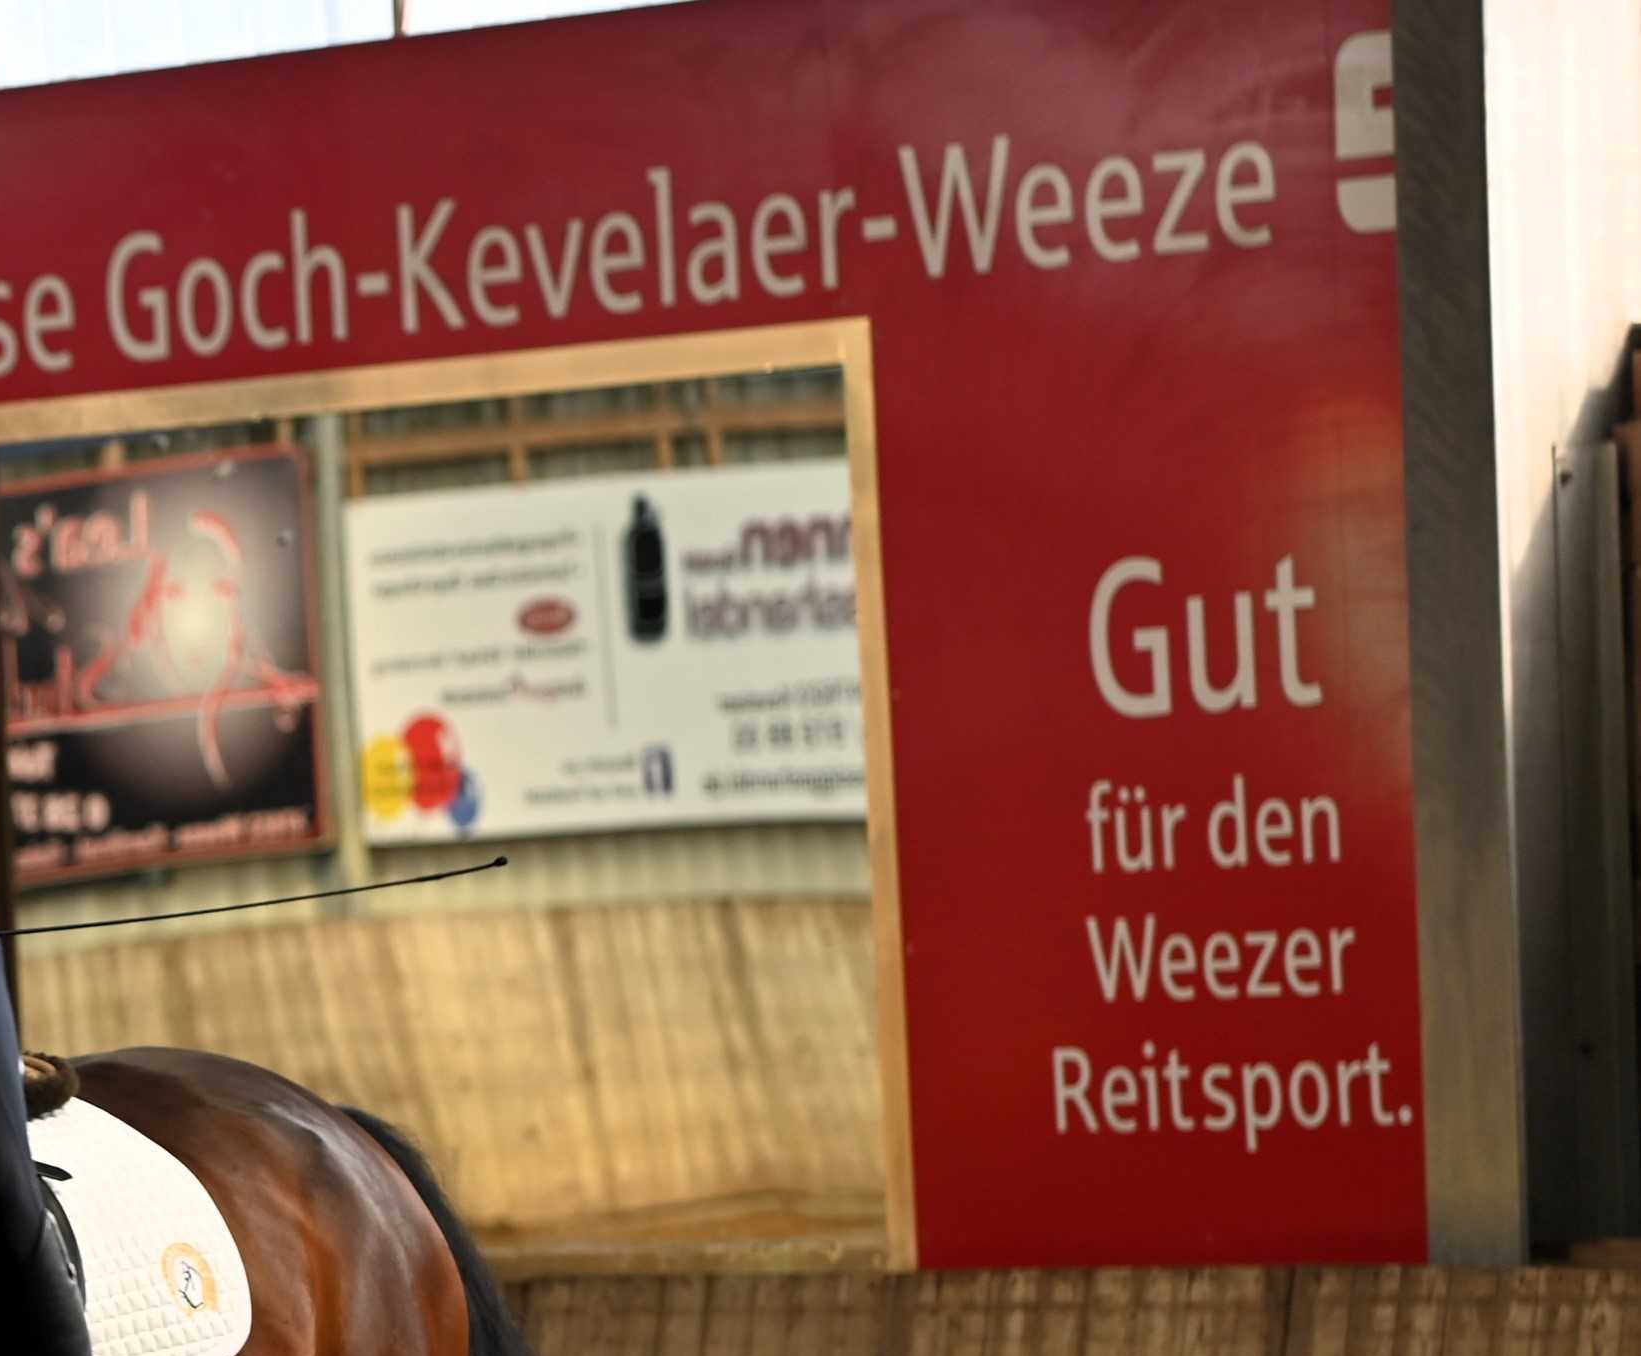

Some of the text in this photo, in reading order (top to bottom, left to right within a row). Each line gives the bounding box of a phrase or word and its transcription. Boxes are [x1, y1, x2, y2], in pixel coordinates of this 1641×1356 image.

[104, 133, 1276, 363] Goch-Kevelaer-Weeze
[1088, 552, 1324, 720] Gut
[1085, 772, 1342, 874] für den
[1085, 912, 1357, 1004] Weezer
[1052, 1040, 1414, 1153] Reitsport.
